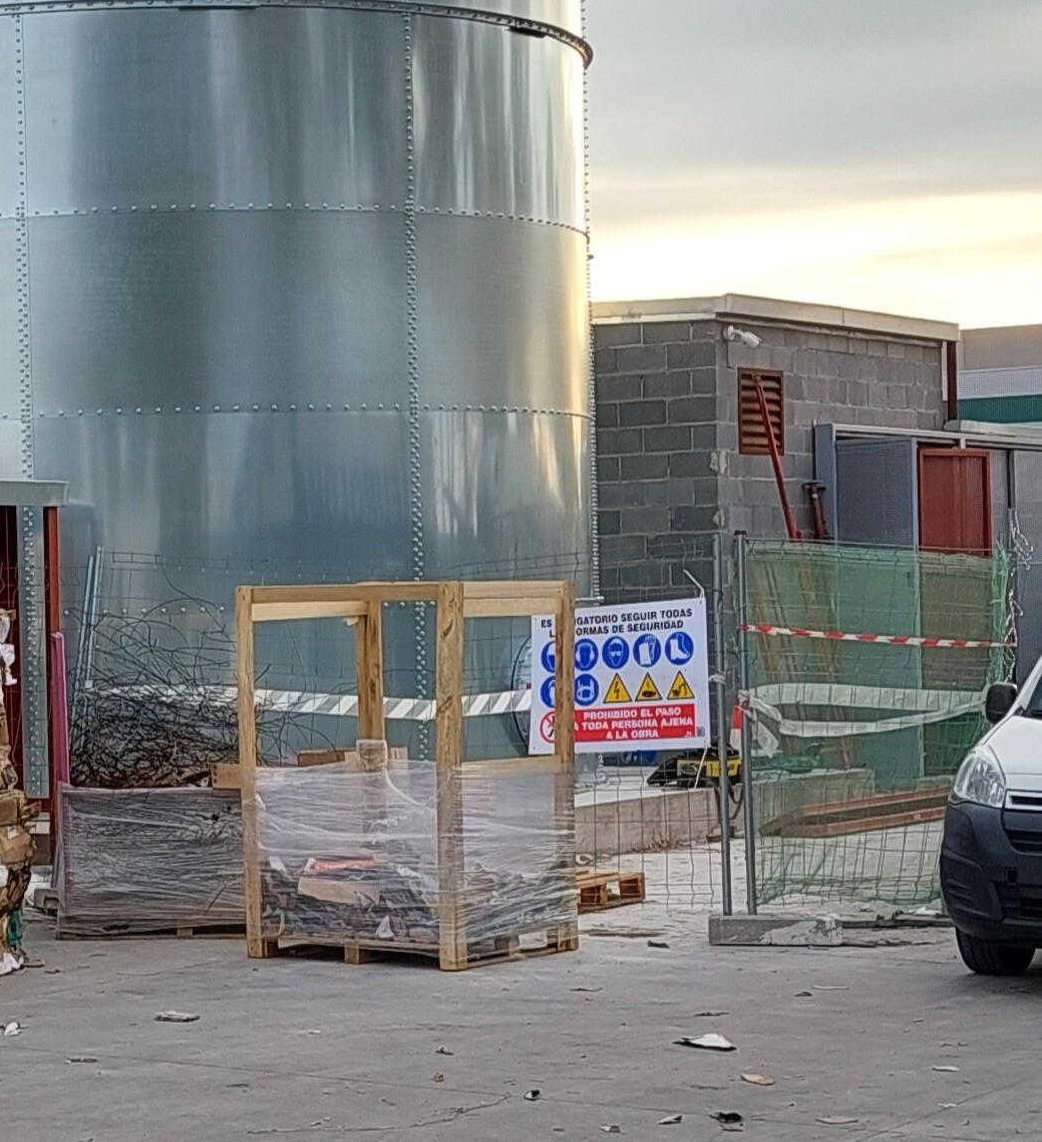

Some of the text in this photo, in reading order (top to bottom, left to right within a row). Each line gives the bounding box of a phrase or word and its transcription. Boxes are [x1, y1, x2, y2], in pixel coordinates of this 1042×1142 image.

[541, 619, 552, 628] ES
[620, 611, 657, 622] SEGUIR
[660, 608, 693, 619] TODAS
[575, 620, 684, 636] ORMAS DE SEGURIDAD
[583, 707, 681, 720] PROHIBIDO EL PASO
[582, 721, 609, 731] TODA
[611, 719, 658, 729] PERSONA
[660, 717, 694, 728] AJENA
[605, 729, 660, 740] A LA OBRA
